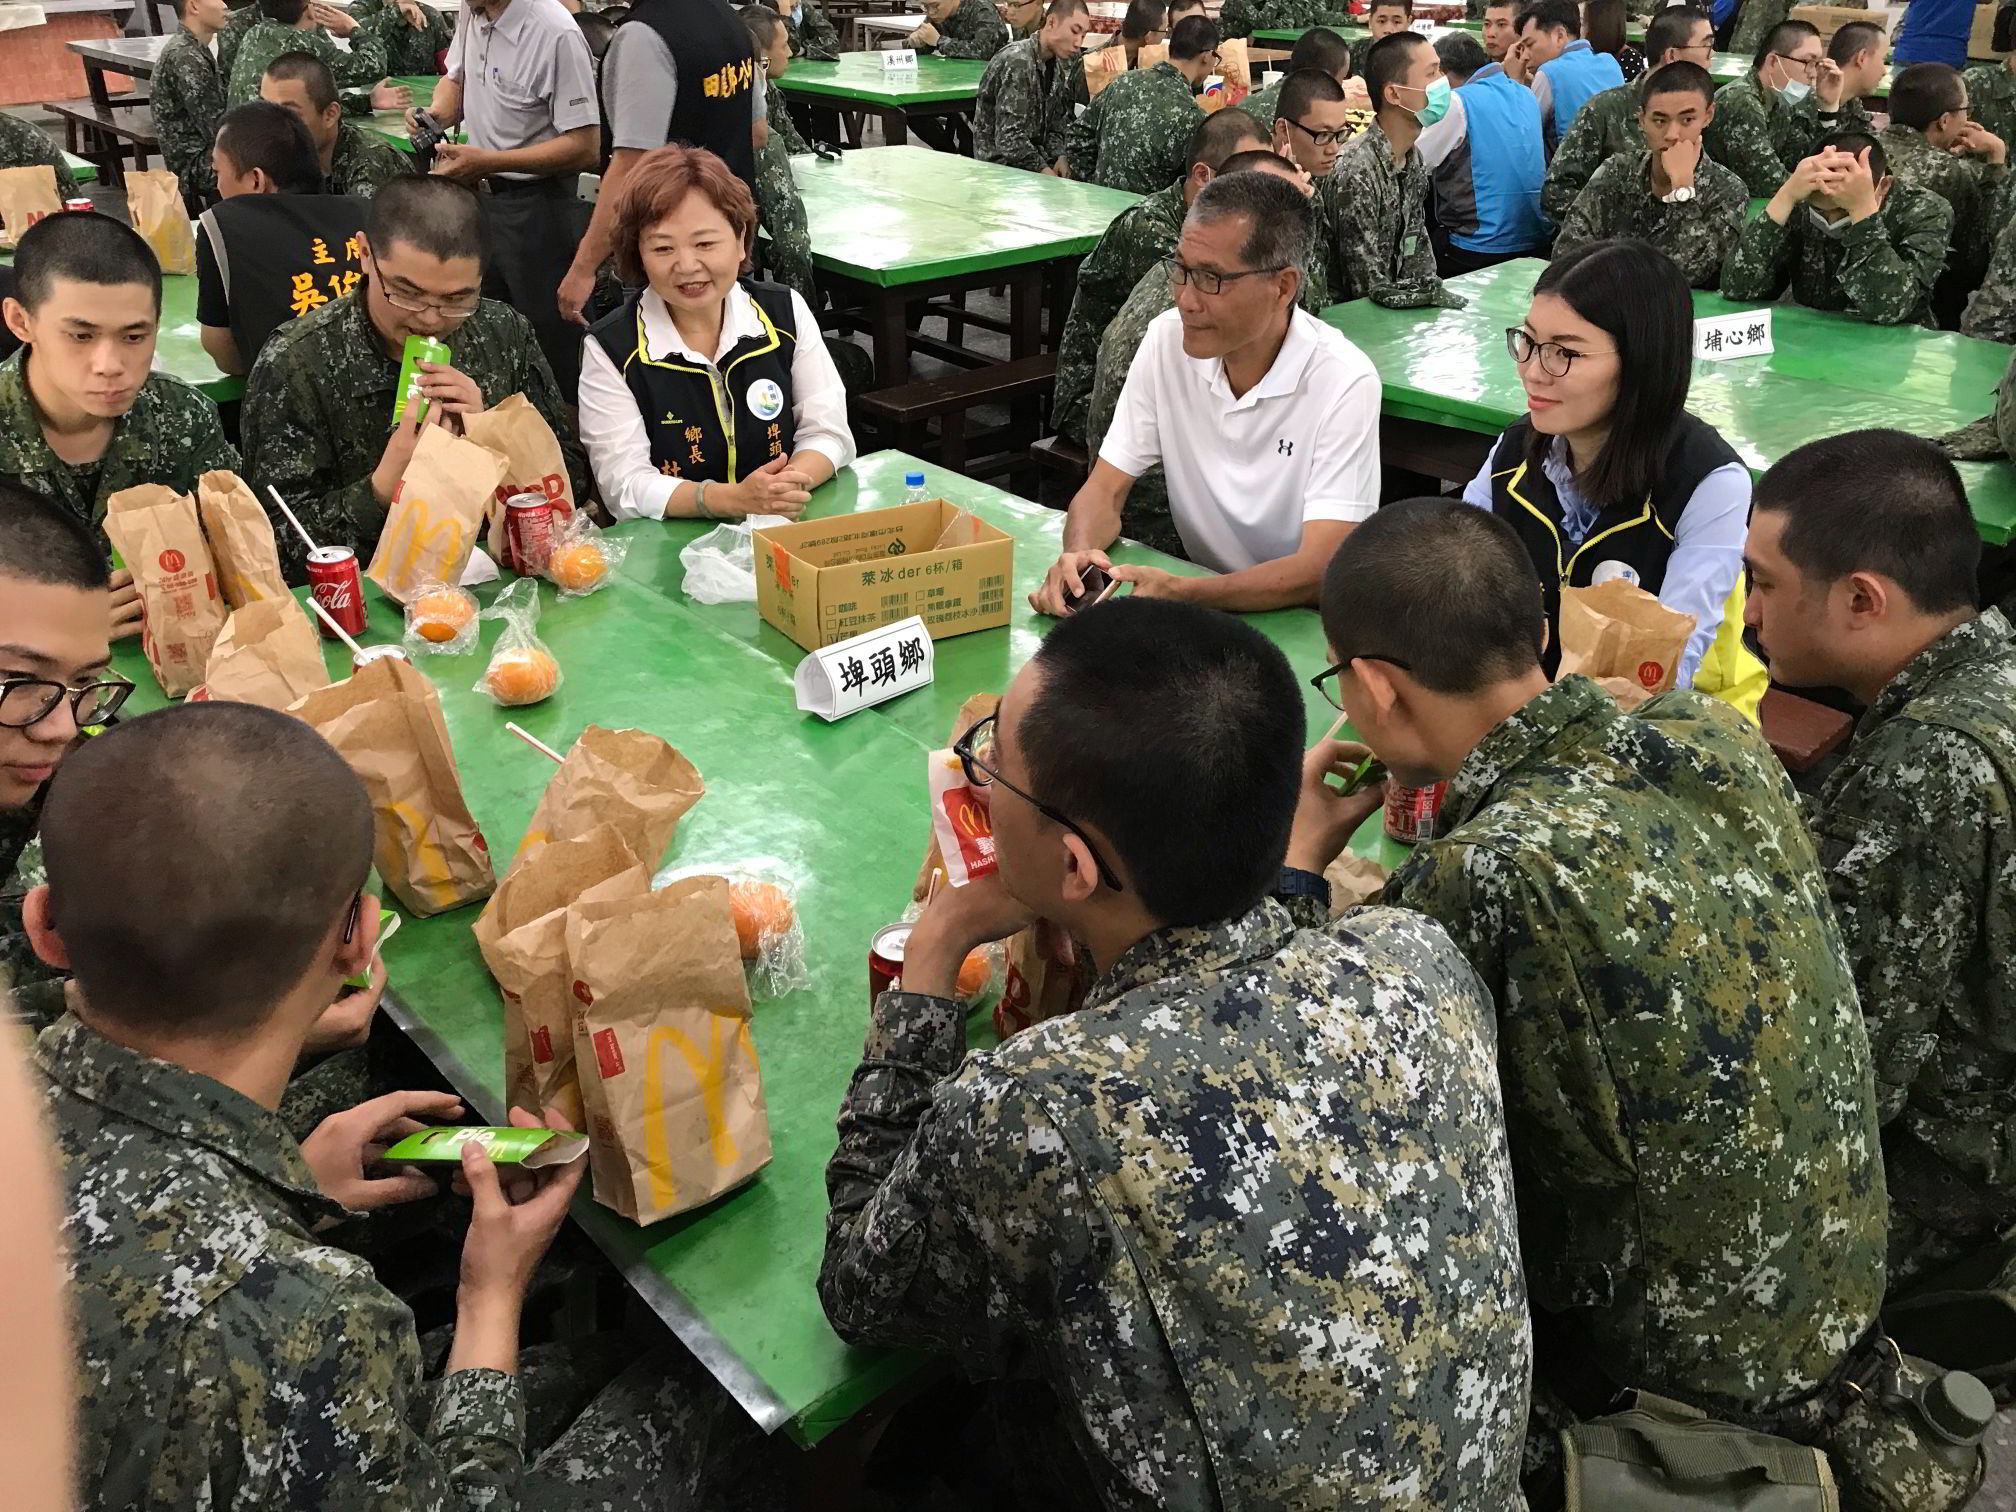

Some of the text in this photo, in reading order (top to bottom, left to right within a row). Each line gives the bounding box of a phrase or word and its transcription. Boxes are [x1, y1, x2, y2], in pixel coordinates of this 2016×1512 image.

[1703, 323, 1766, 353] 埔心鄉
[684, 425, 706, 465] 鄉長
[839, 612, 876, 628] 紅豆抹茶
[837, 636, 925, 698] 埤頭鄉
[970, 857, 995, 870] HASH
[448, 1128, 497, 1146] Pie
